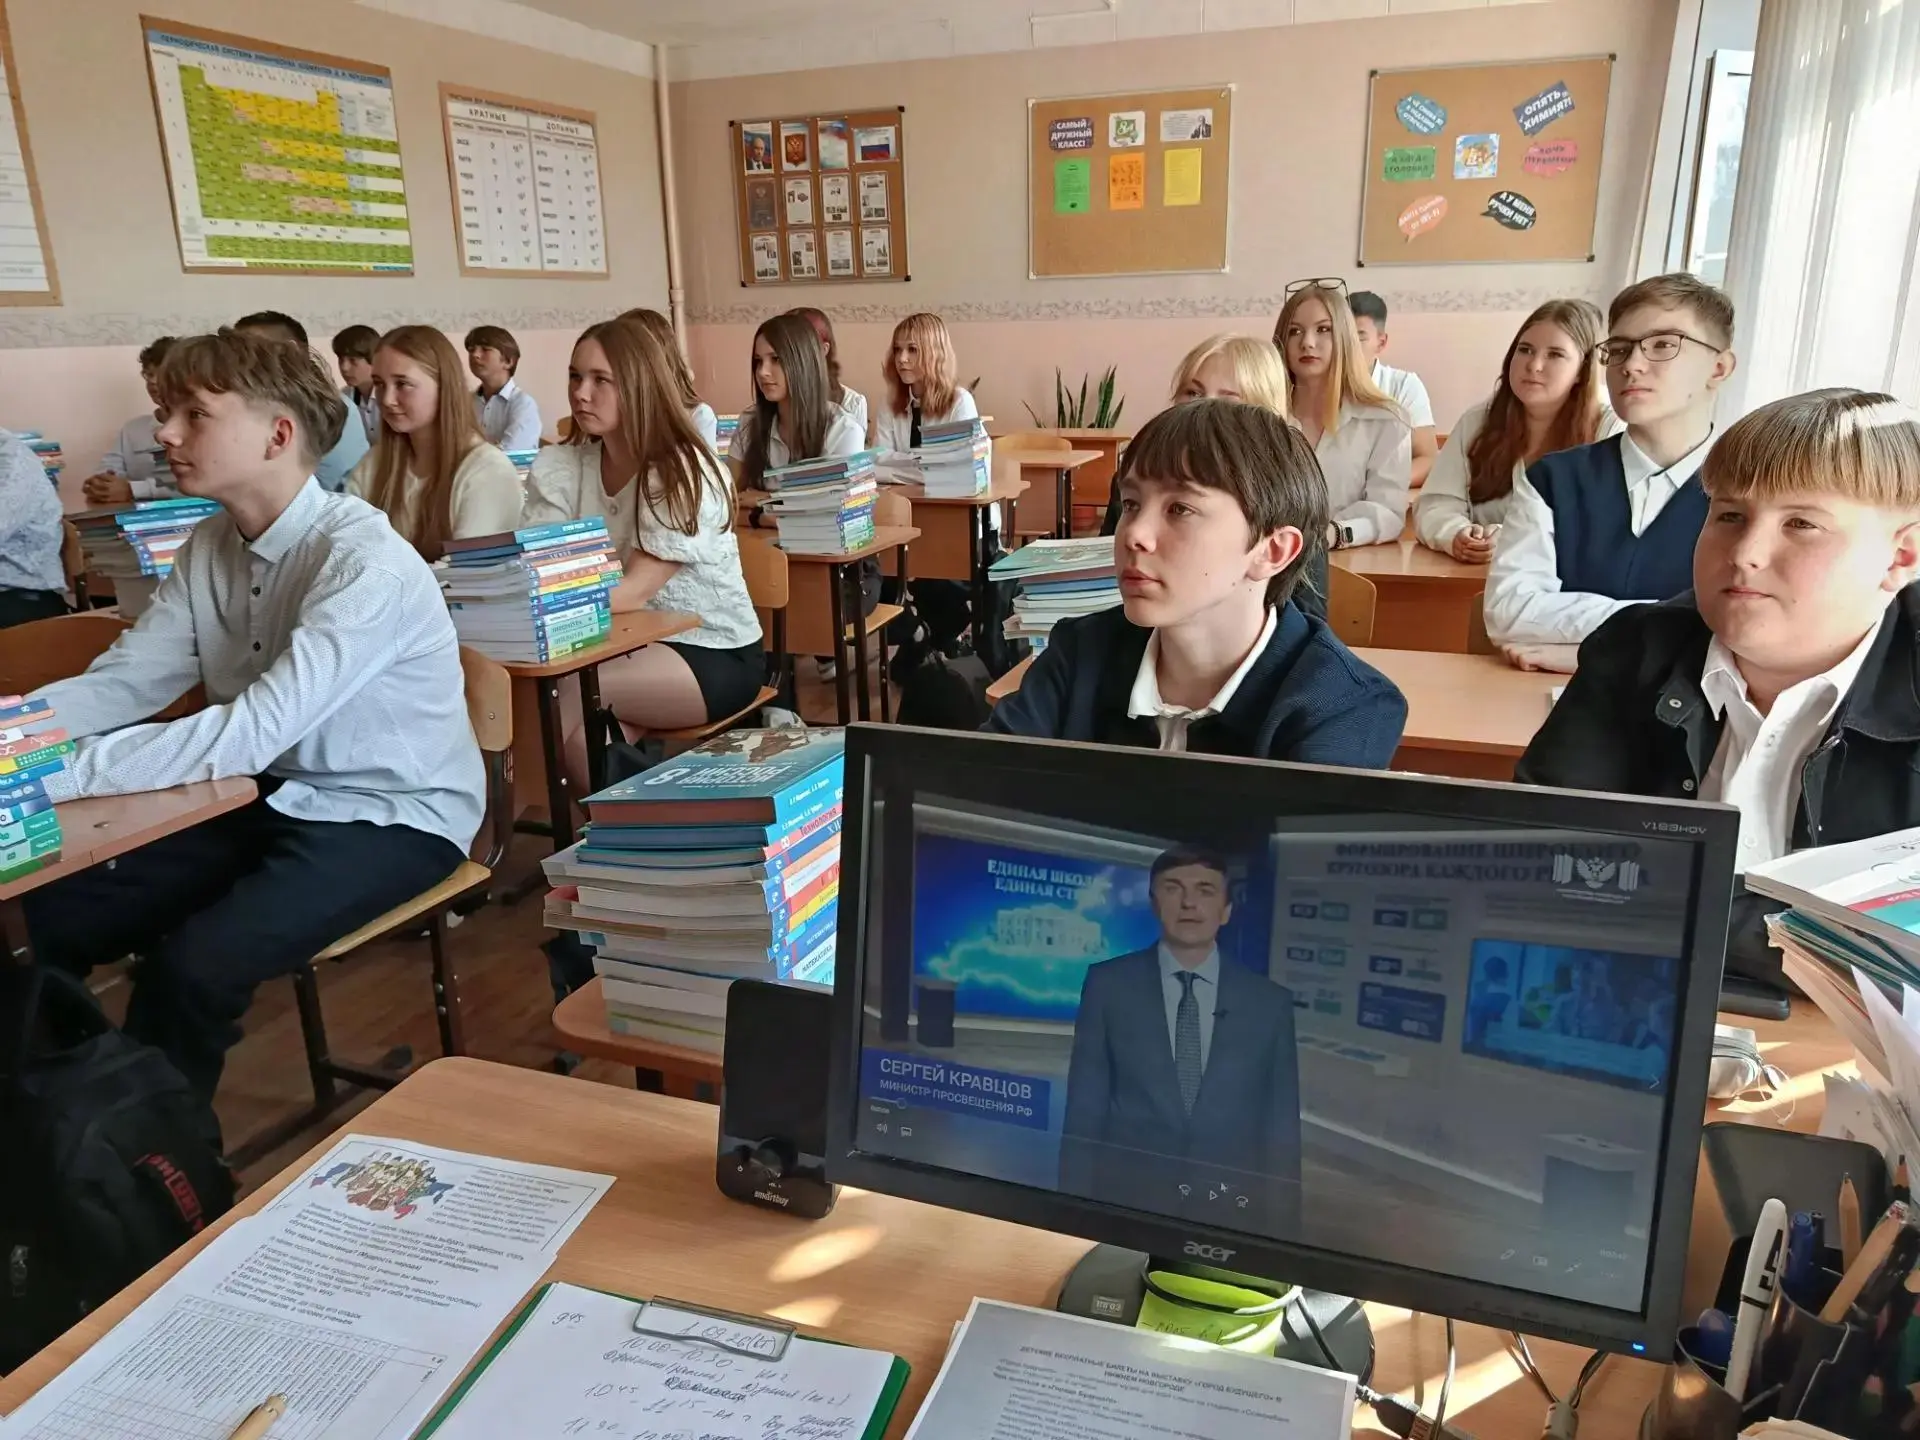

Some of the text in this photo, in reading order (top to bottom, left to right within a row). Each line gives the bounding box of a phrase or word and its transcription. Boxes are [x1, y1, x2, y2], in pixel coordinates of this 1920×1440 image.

[1524, 90, 1561, 115] ОПЯТЬ
[469, 108, 507, 122] КРАТНЫЕ
[1056, 119, 1087, 130] САМЫЙ
[1051, 127, 1093, 142] ДРУЖНЫЙ
[1057, 140, 1086, 149] КЛАСС!
[643, 768, 692, 785] 8
[987, 859, 1048, 881] ЕДИНАЯ
[994, 877, 1054, 898] ЕДИНАЯ
[801, 944, 834, 973] МАТЕМАТИКА
[880, 1058, 1032, 1099] СЕРГЕЙ КРАВЦОВ
[879, 1079, 1033, 1118] МИНИСТР ПРОСВЕЩЕНИЯ РФ
[1183, 1240, 1237, 1262] acer
